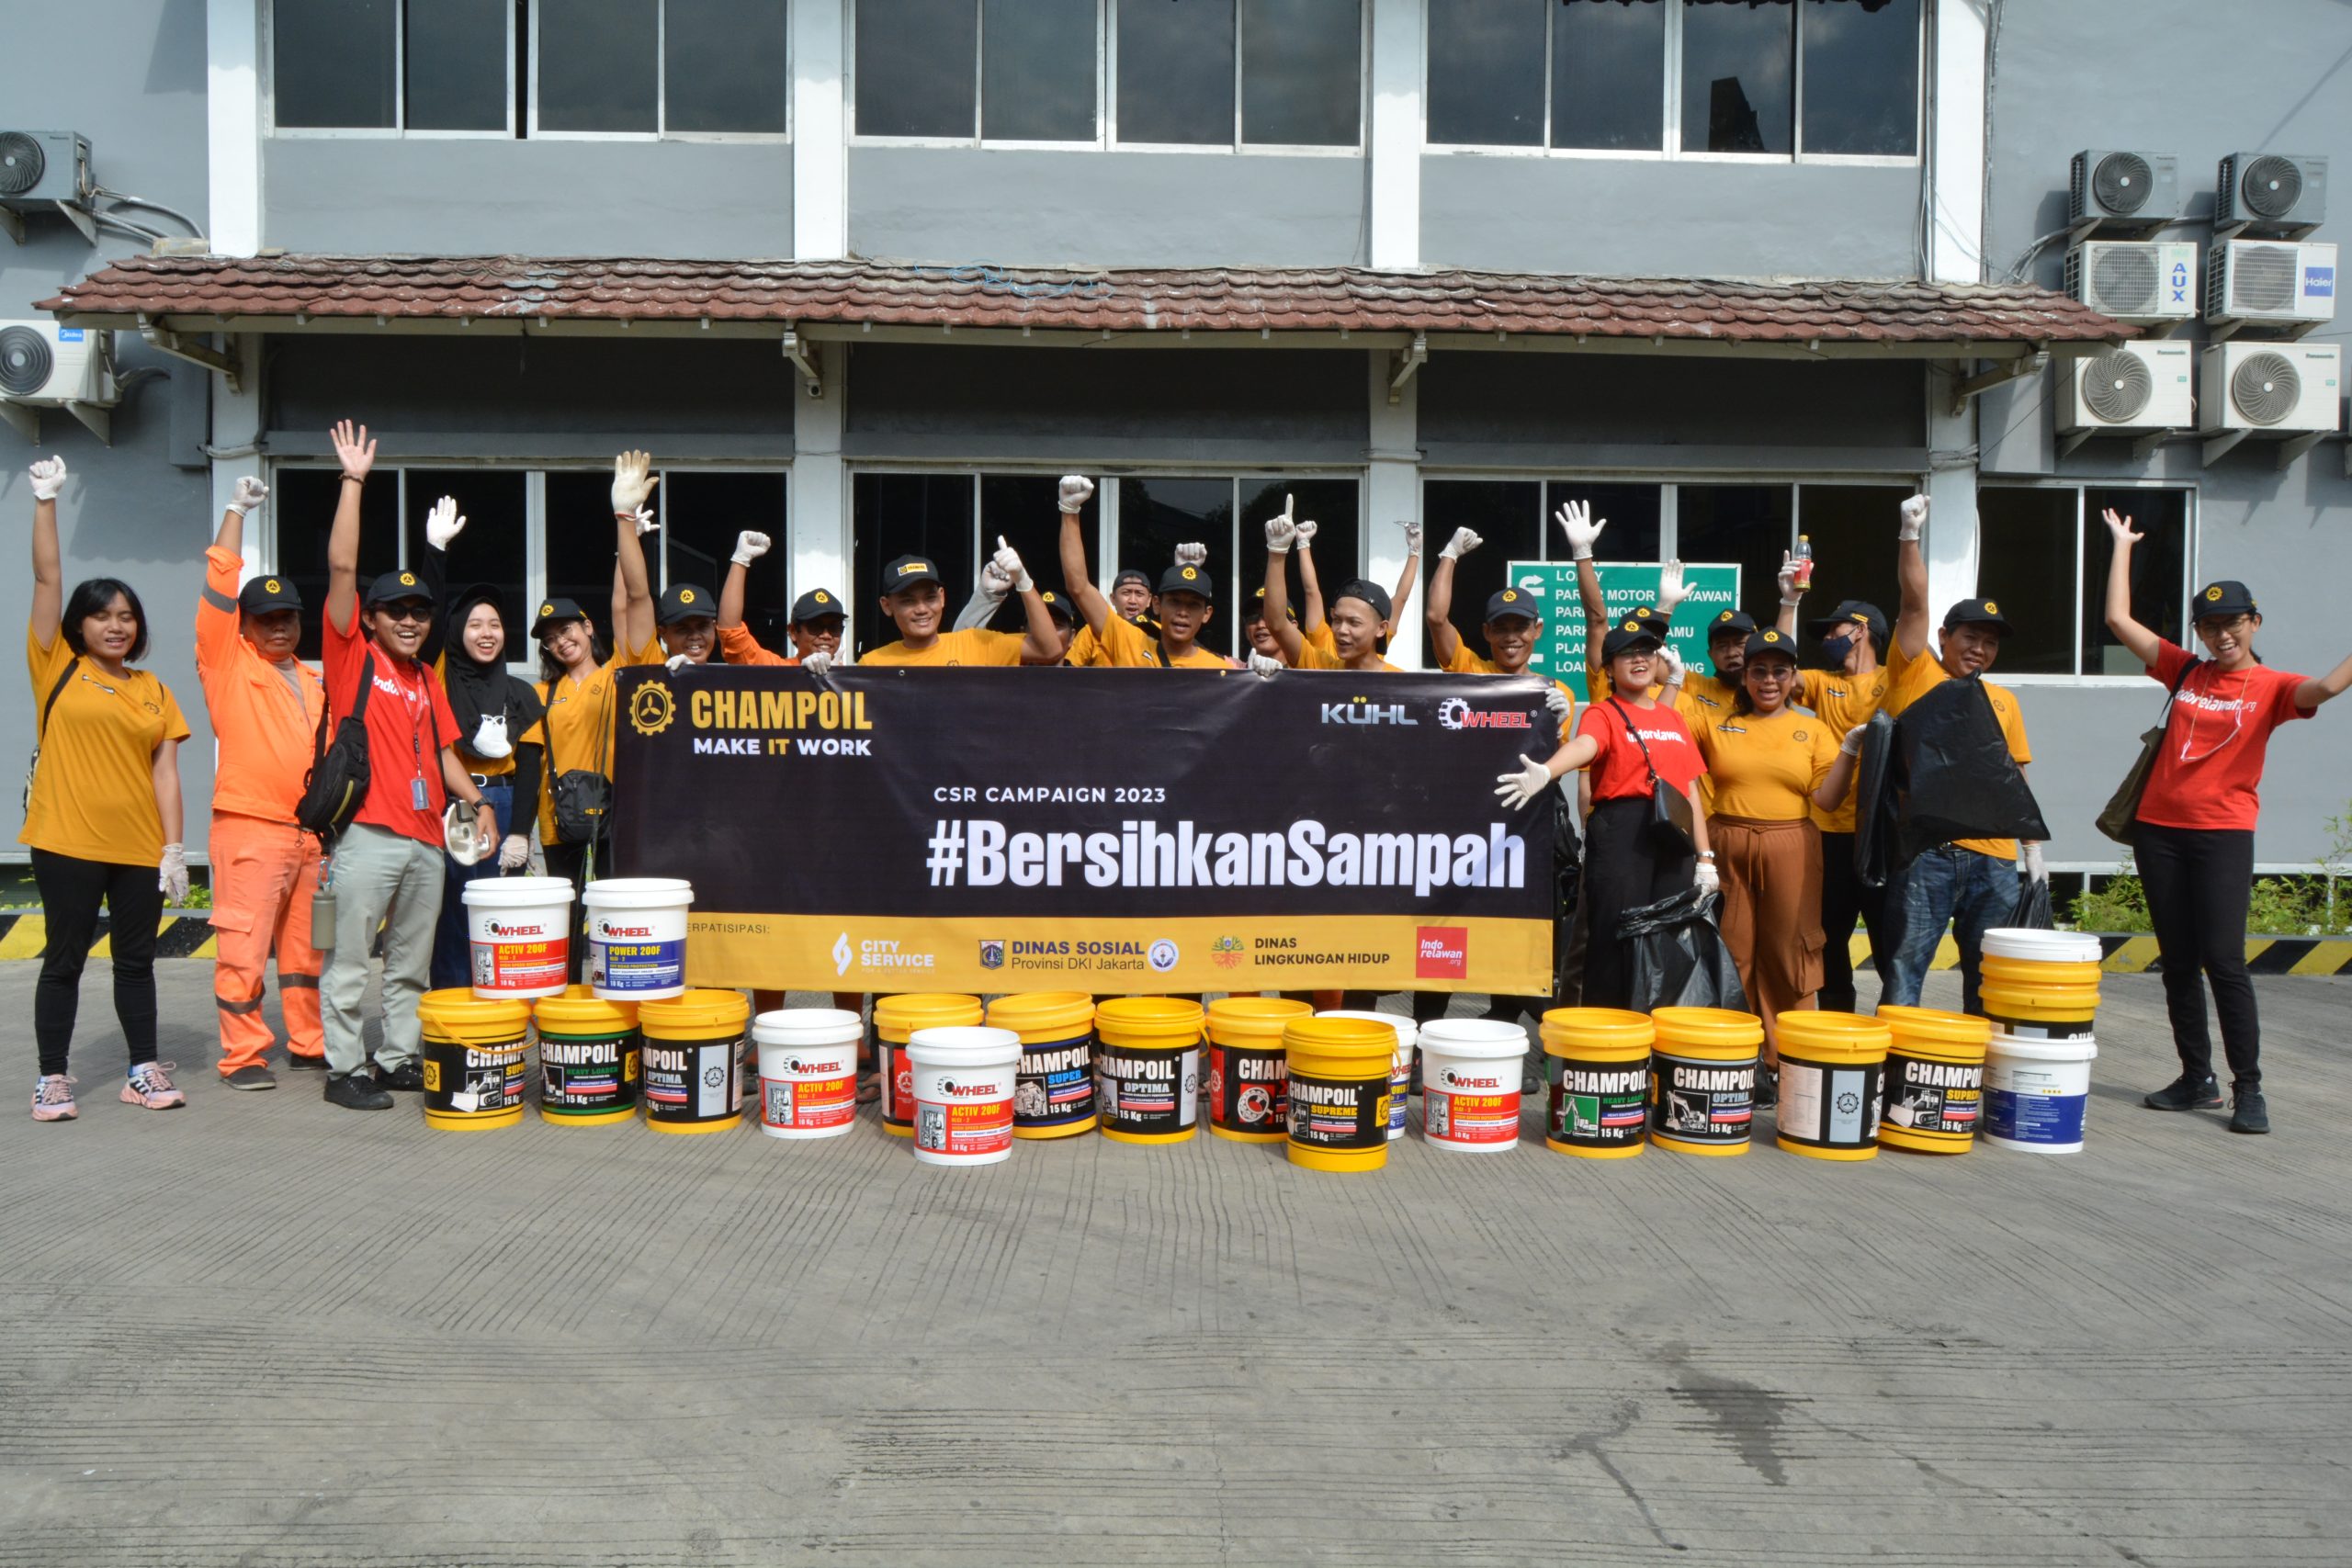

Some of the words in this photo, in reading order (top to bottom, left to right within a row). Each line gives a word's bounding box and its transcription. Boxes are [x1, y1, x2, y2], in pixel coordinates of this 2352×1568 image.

[2172, 263, 2187, 301] AUX
[2304, 277, 2332, 288] Haier
[1556, 570, 1603, 581] LOY
[1607, 590, 1655, 602] MOTOR
[1684, 591, 1732, 602] YAWAN
[1667, 626, 1694, 637] AMU
[691, 690, 873, 730] CHAMPOIL
[1321, 696, 1419, 725] KÜHL
[1460, 711, 1532, 728] WHEEL
[694, 738, 760, 755] MAKE
[768, 739, 787, 755] IT
[797, 739, 871, 756] WORK
[933, 787, 976, 802] CSR
[985, 786, 1105, 803] CAMPAIGN
[1114, 787, 1166, 803] 2023
[926, 819, 1525, 897] #BersihkanSampah
[497, 925, 544, 936] WHEEL
[608, 926, 651, 936] WHEEL
[686, 922, 770, 934] ERPATISIPASI:
[499, 945, 524, 954] ACTIV
[526, 943, 548, 953] 200F
[861, 940, 900, 953] CITY
[1012, 941, 1069, 954] DINAS
[1076, 942, 1145, 955] SOSIAL
[1255, 937, 1296, 949] DINAS
[1421, 939, 1443, 949] Indo
[609, 946, 638, 955] POWER
[640, 945, 661, 955] 200F
[1420, 948, 1463, 959] relawan
[861, 953, 934, 967] SERVICE
[1012, 957, 1064, 970] Provinsi
[1068, 957, 1091, 970] DKI
[1096, 958, 1145, 970] Jakarta
[1255, 953, 1344, 965] LINGKUNGAN
[1348, 953, 1390, 964] HIDUP
[467, 1042, 525, 1067] CHAMP
[540, 1042, 618, 1064] CHAMPOIL
[644, 1046, 687, 1071] MPOIL
[797, 1062, 842, 1073] WHEEL
[1100, 1054, 1175, 1080] HAMPOIL
[1238, 1059, 1288, 1079] CHAM
[1048, 1070, 1081, 1084] SUPER
[1454, 1078, 1499, 1088] WHEEL
[1563, 1069, 1646, 1093] CHAMPOIL
[1674, 1066, 1754, 1091] CHAMPOIL
[797, 1083, 823, 1092] ACTIV
[825, 1080, 843, 1091] 200F
[952, 1085, 998, 1096] WHEEL
[1125, 1083, 1170, 1093] OPTIMA
[566, 1095, 575, 1103] 15
[577, 1095, 588, 1104] Kg
[1289, 1081, 1358, 1106] CHAMPOIL
[1713, 1092, 1748, 1102] OPTIMA
[1454, 1096, 1479, 1107] ACTIV
[1483, 1097, 1502, 1107] 200F
[952, 1106, 978, 1116] ACTIV
[981, 1104, 1000, 1115] 200F
[1050, 1104, 1060, 1113] 15
[1061, 1103, 1071, 1113] Kg
[1311, 1105, 1357, 1116] SUPREME
[1120, 1111, 1129, 1119] 15
[1130, 1111, 1141, 1122] Kg
[1275, 1114, 1283, 1122] 15
[1710, 1123, 1720, 1133] 15
[1722, 1123, 1732, 1134] Kg
[1941, 1121, 1951, 1131] 15
[1952, 1121, 1962, 1132] Kg
[1310, 1131, 1317, 1139] 15
[1318, 1133, 1329, 1142] Kg
[1601, 1128, 1611, 1138] 15
[1613, 1128, 1623, 1139] Kg
